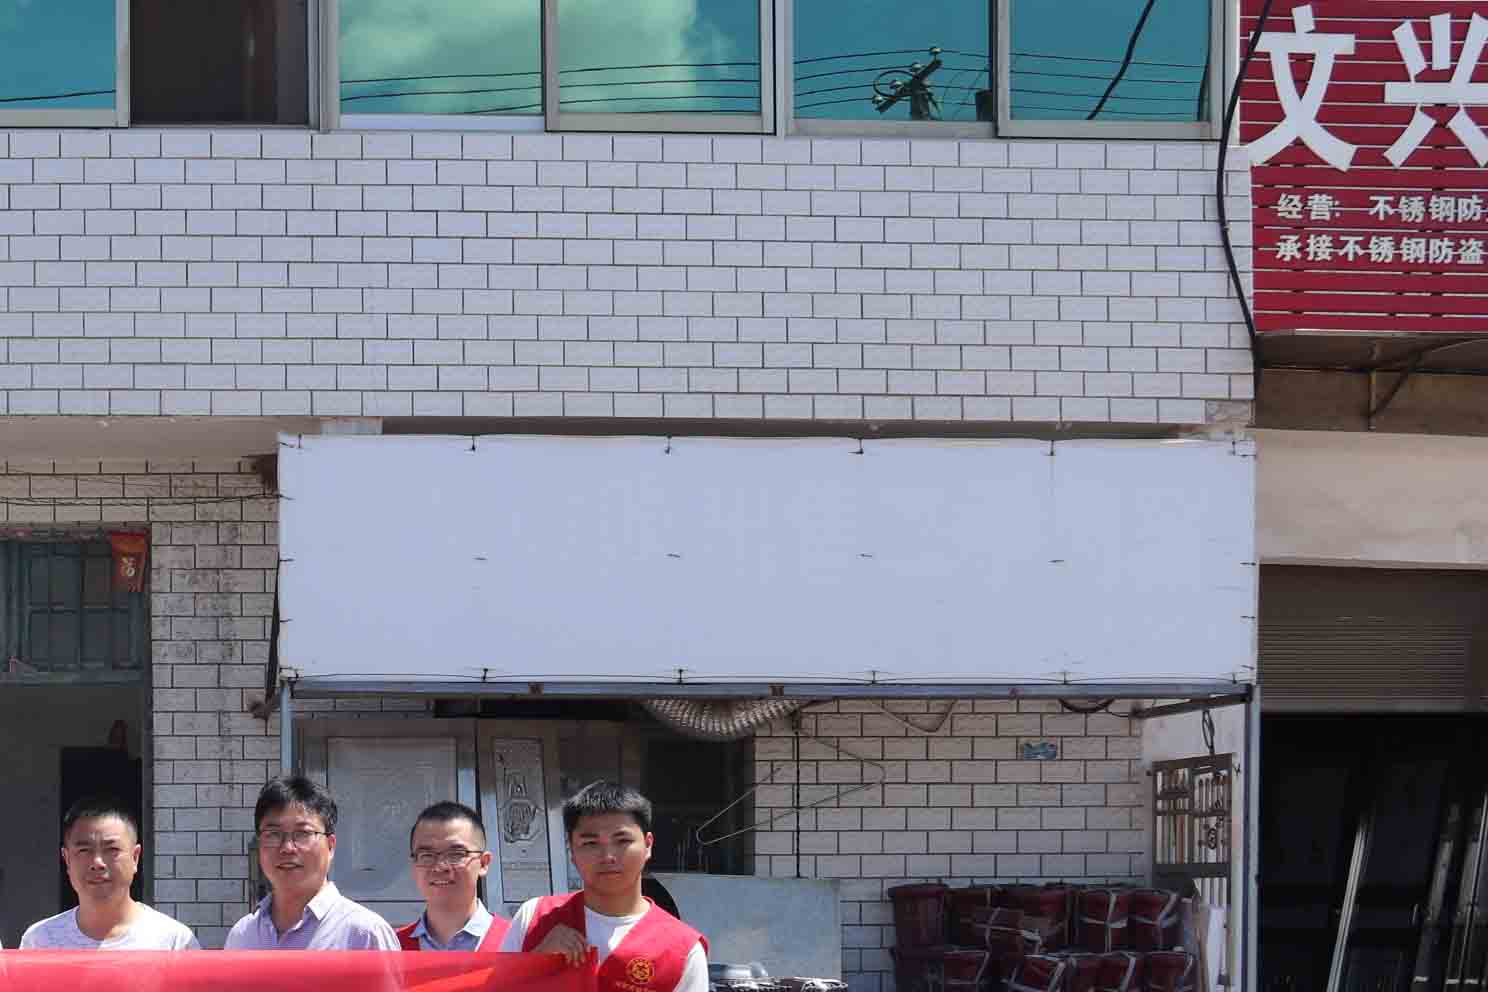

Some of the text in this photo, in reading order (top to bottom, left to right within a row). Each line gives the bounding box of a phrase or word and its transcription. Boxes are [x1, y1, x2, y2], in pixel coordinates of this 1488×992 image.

[1247, 4, 1488, 172] 文兴
[1369, 195, 1488, 223] 不锈钢防
[1275, 234, 1485, 265] 承接不锈钢防盗
